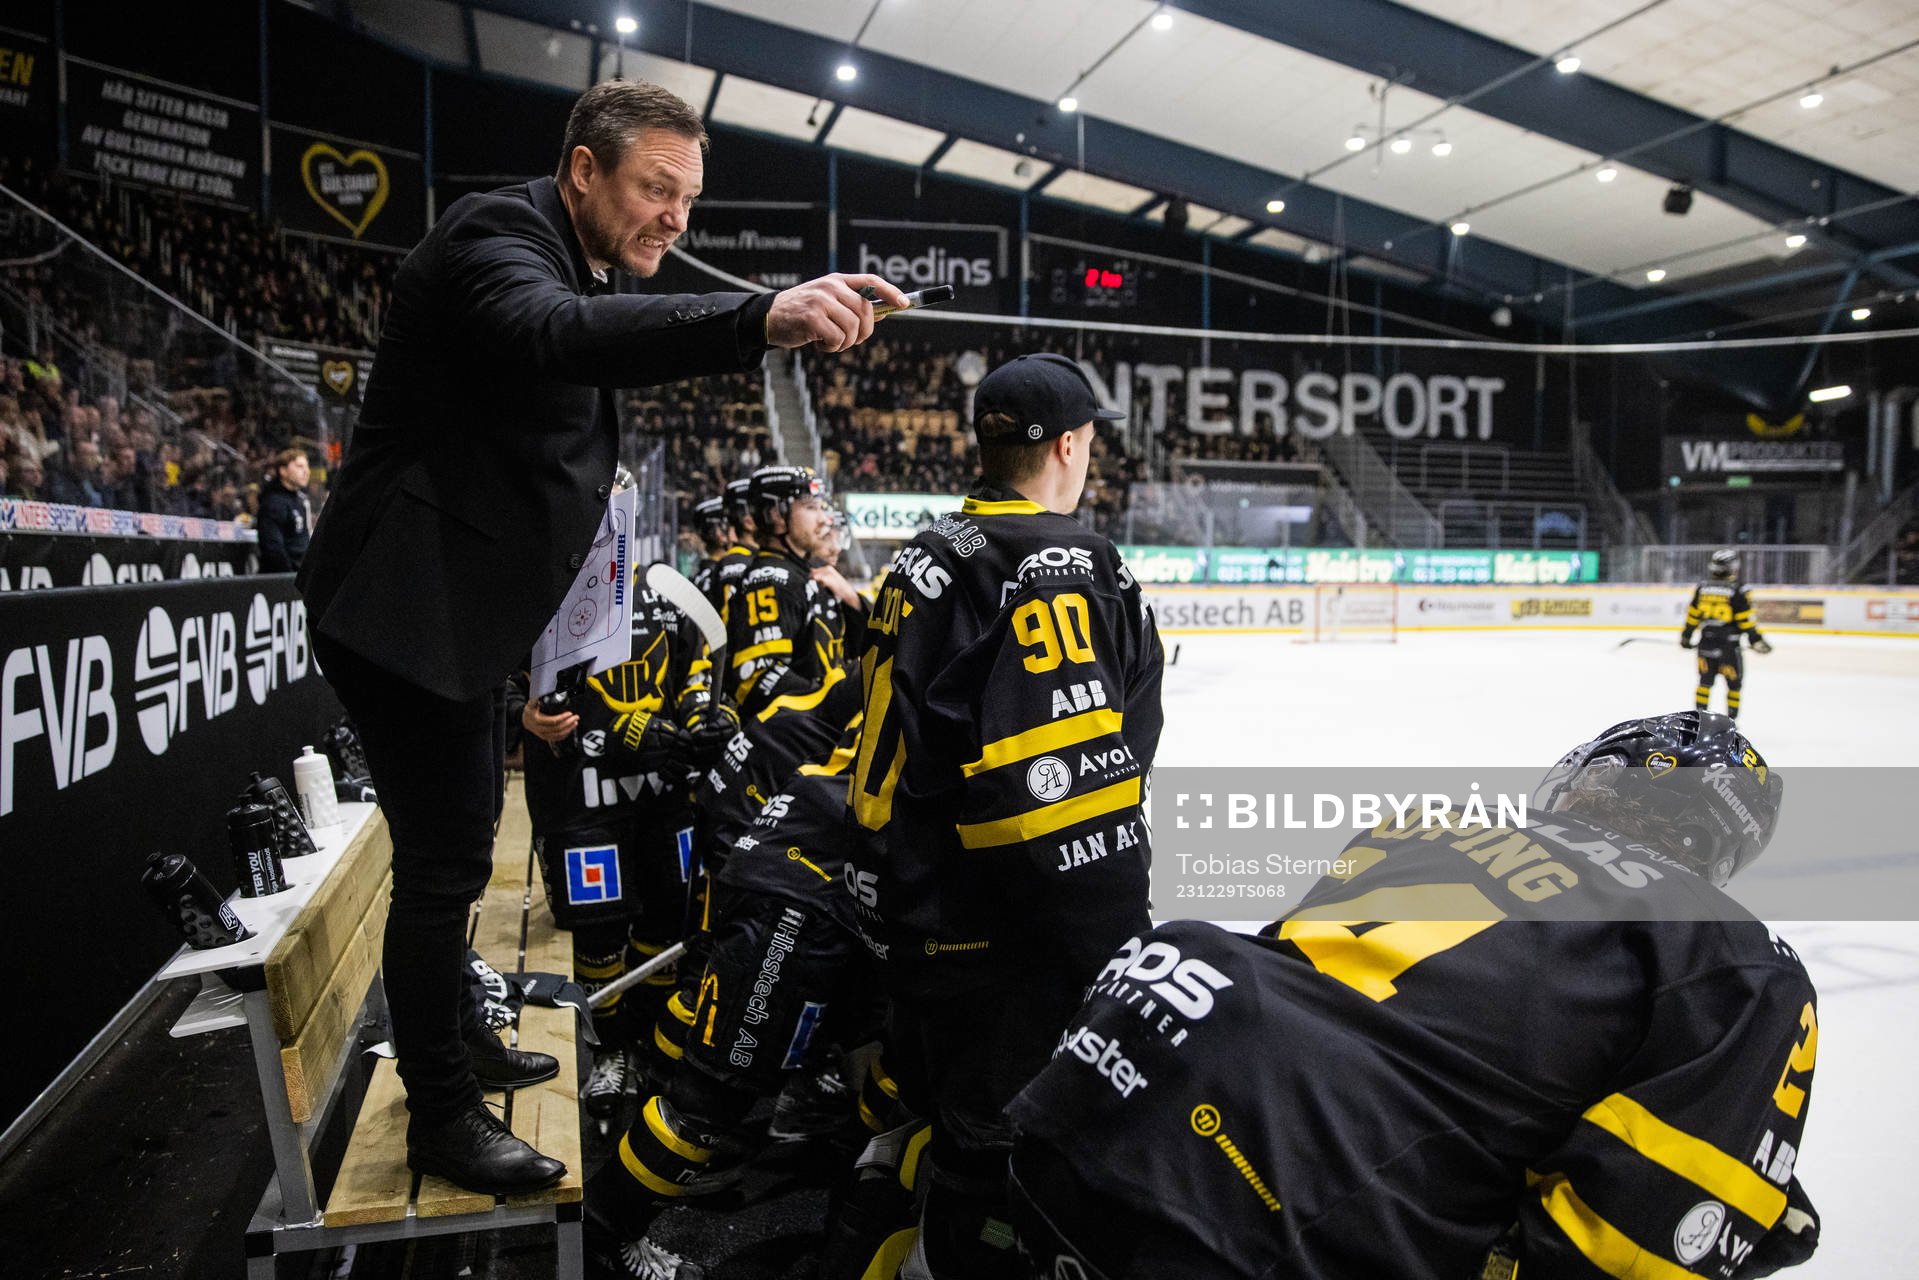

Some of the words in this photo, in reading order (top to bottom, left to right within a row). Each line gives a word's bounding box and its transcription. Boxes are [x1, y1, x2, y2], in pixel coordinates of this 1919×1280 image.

[1078, 358, 1505, 441] NTERSPORT
[1680, 440, 1729, 472] VM
[951, 525, 987, 558] AB
[614, 533, 627, 606] WARRIOR
[745, 585, 780, 627] 15
[1154, 597, 1254, 627] isstech
[1264, 599, 1305, 627] AB
[754, 625, 784, 645] ABB
[1011, 592, 1097, 675] 90
[179, 611, 239, 733] FVB
[1052, 679, 1107, 719] ABB
[0, 634, 119, 818] FVB
[1701, 762, 1762, 848] Kinnarps
[247, 852, 262, 873] YOU
[1057, 831, 1108, 873] JAN
[729, 1027, 758, 1068] AB
[1752, 1128, 1798, 1187] AB
